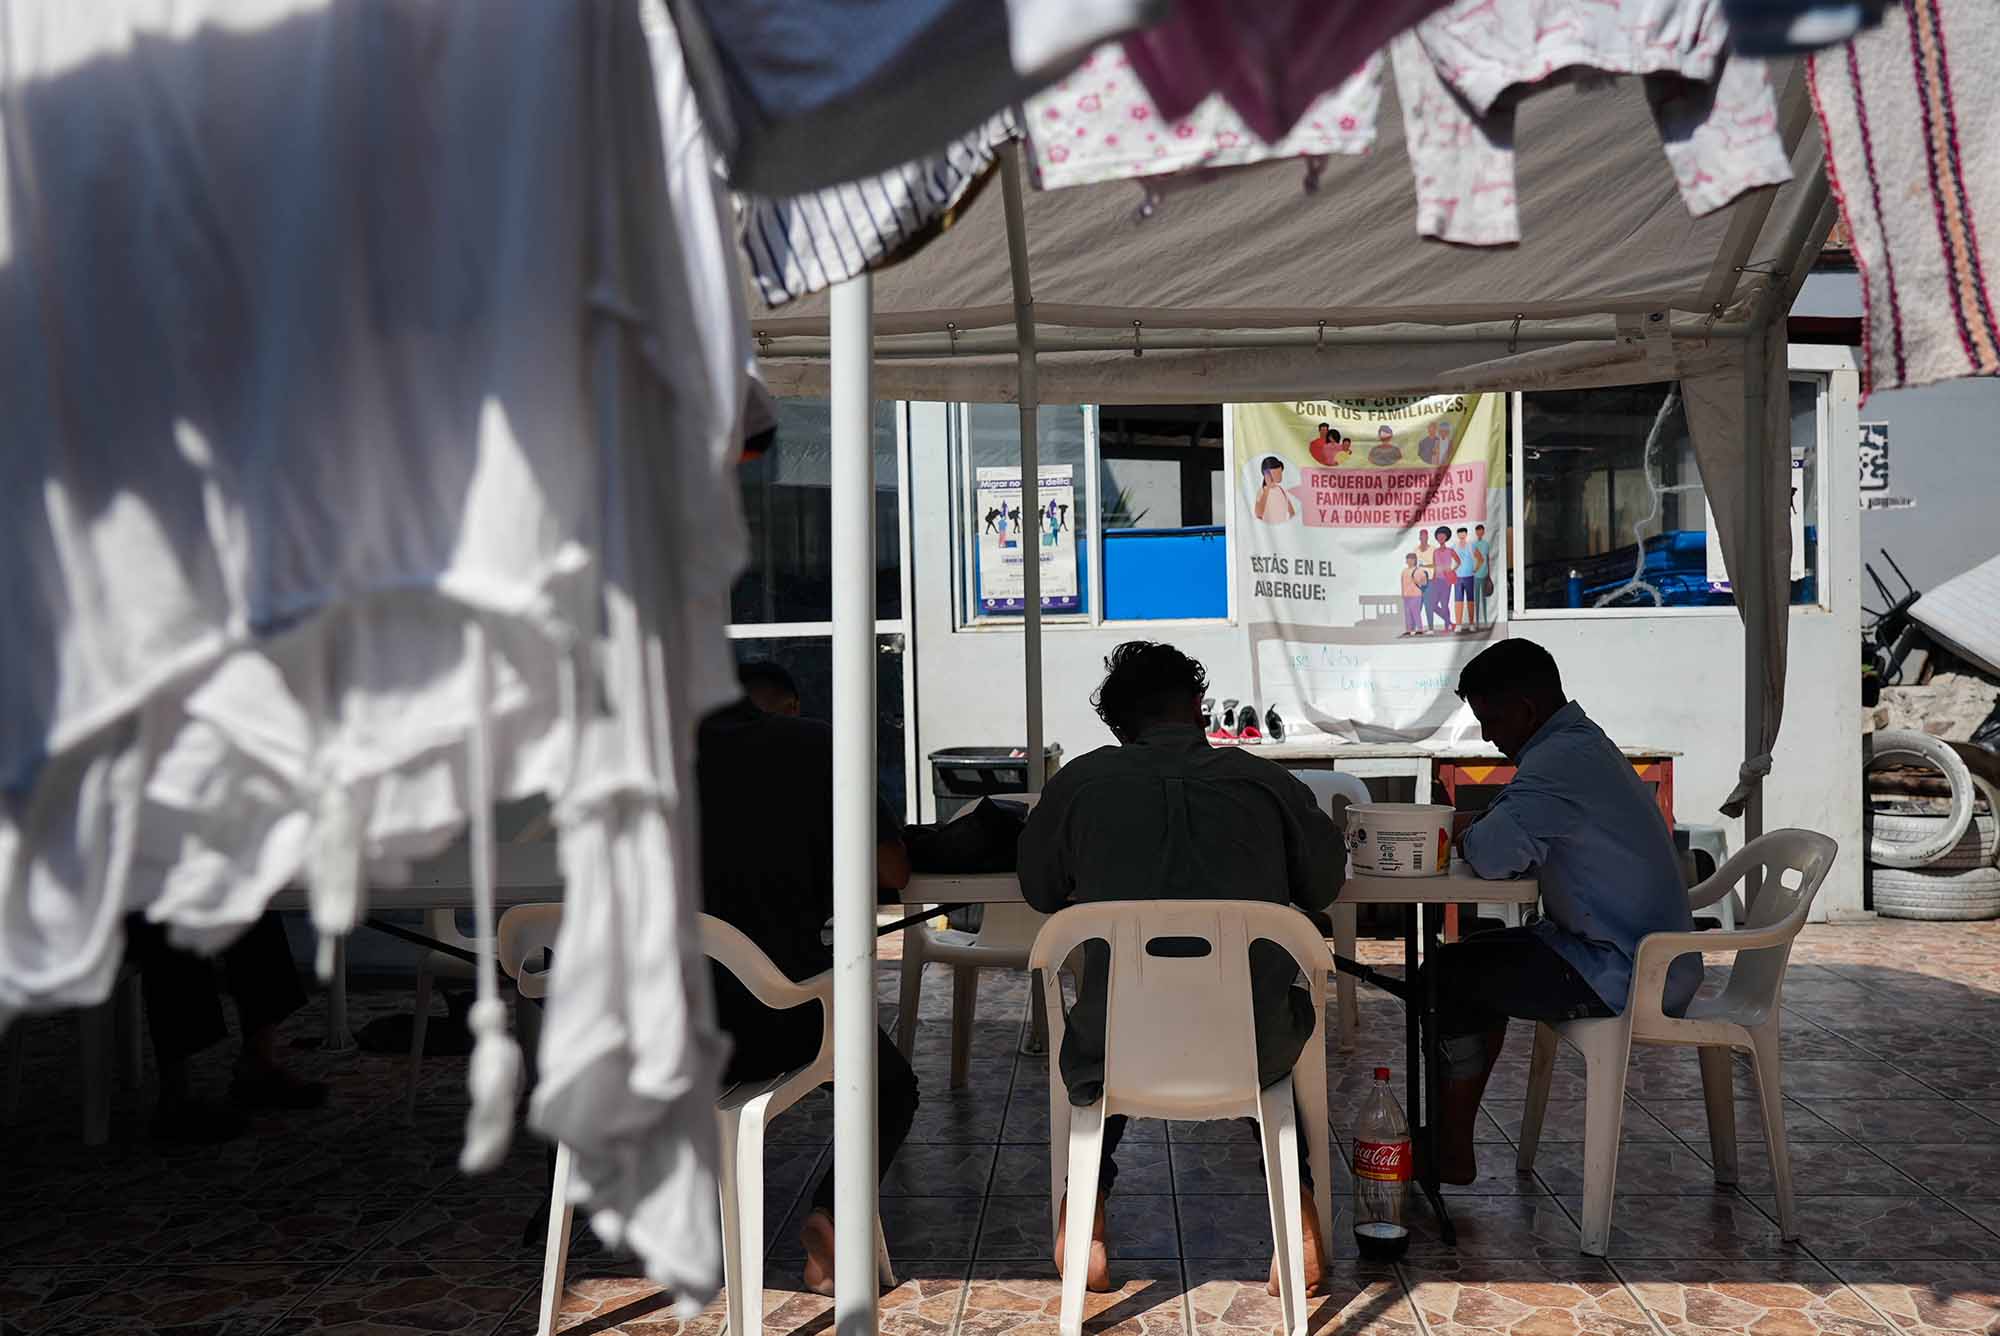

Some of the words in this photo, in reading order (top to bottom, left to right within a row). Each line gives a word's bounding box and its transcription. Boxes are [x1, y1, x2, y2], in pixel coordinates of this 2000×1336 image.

[1296, 401, 1327, 417] CON
[1332, 406, 1361, 421] TUS
[1368, 397, 1468, 421] FAMILIARES,
[1311, 473, 1383, 489] RECUERDA
[1387, 472, 1442, 488] DECIRLE
[1444, 471, 1454, 486] A
[1456, 469, 1473, 484] TU
[1316, 491, 1370, 507] FAMILIA
[1376, 488, 1421, 507] DÓNDE
[1426, 486, 1465, 504] ESTÁS
[1319, 509, 1328, 523] Y
[1330, 510, 1340, 524] A
[1344, 506, 1391, 524] DÓNDE
[1394, 509, 1410, 523] TE
[1414, 505, 1467, 522] DIRIGES
[1251, 553, 1289, 575] ESTÁS
[1295, 559, 1314, 577] EN
[1319, 560, 1337, 578] EL
